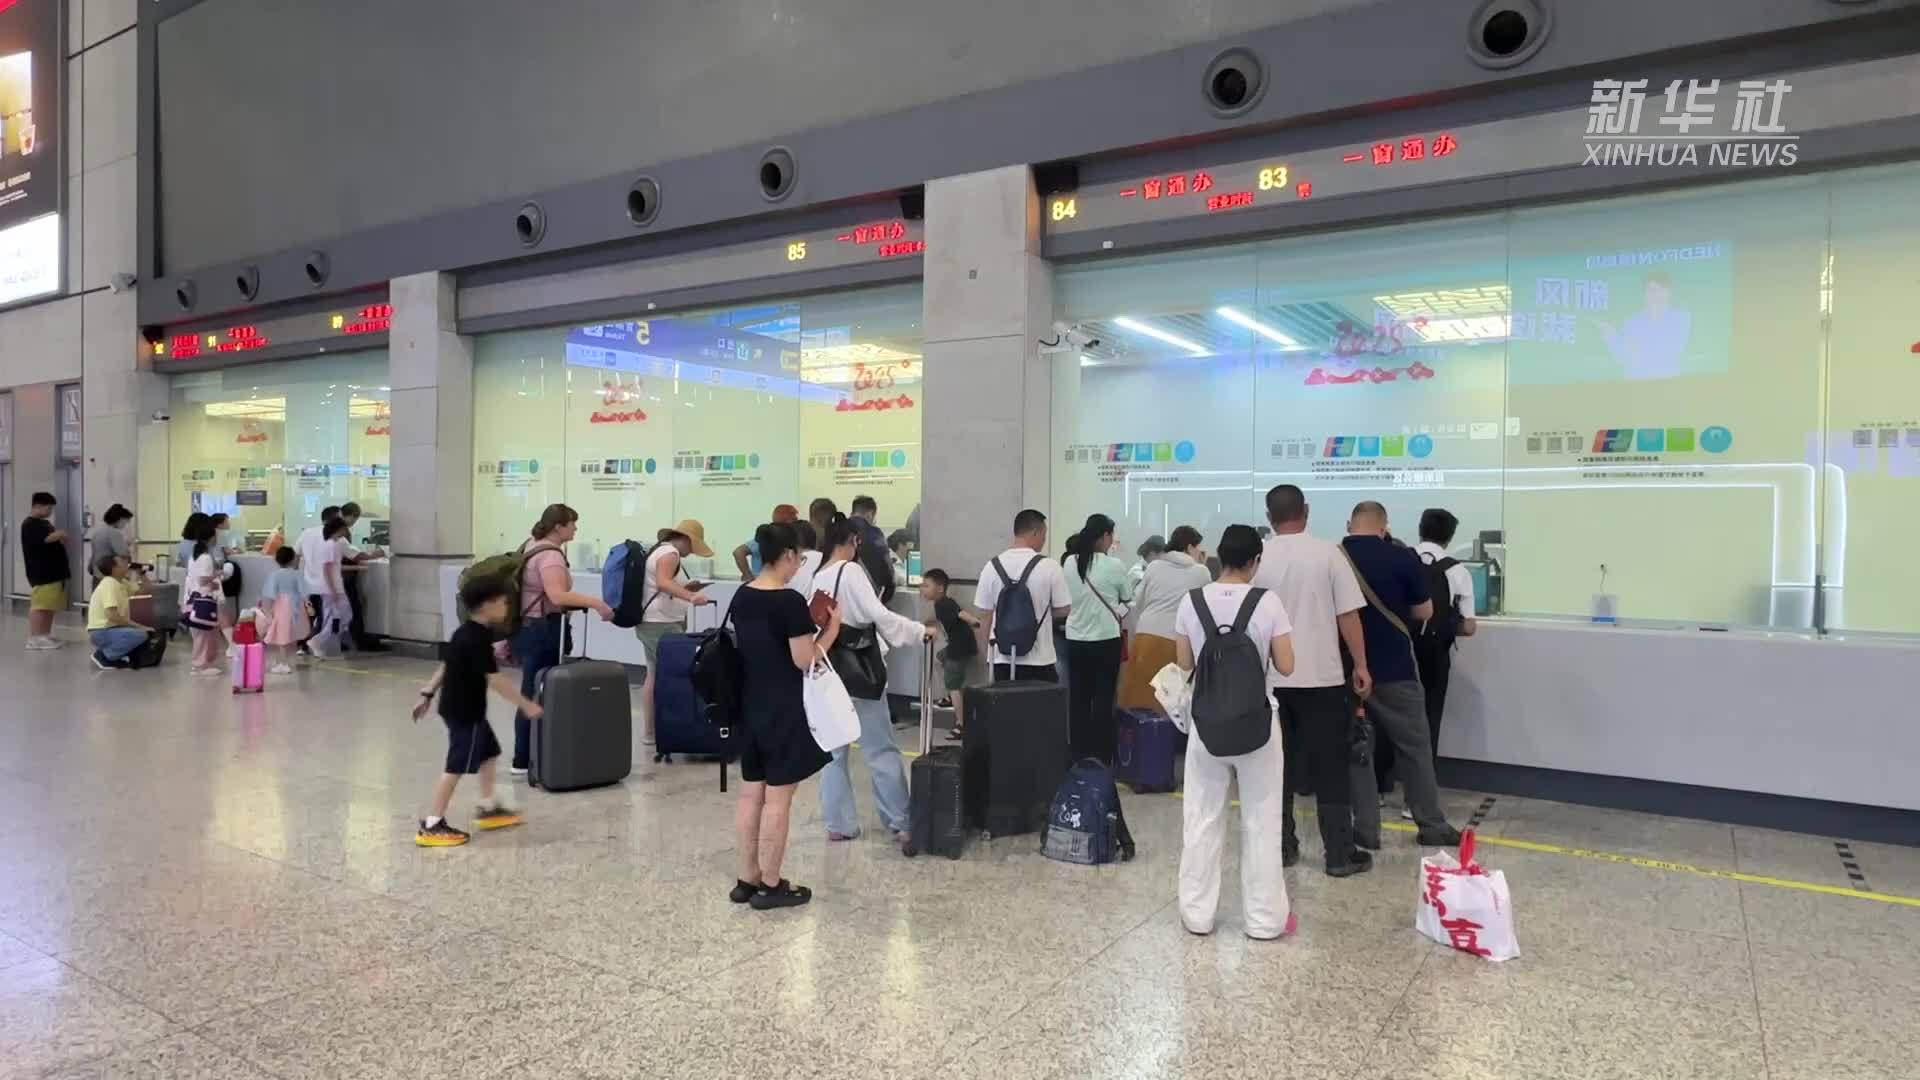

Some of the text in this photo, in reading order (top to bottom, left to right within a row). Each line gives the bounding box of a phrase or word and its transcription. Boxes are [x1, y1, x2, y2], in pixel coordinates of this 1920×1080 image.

[1344, 135, 1457, 165] 一窗通办
[1259, 166, 1288, 190] 83
[1052, 200, 1077, 221] 84
[788, 242, 806, 261] 85
